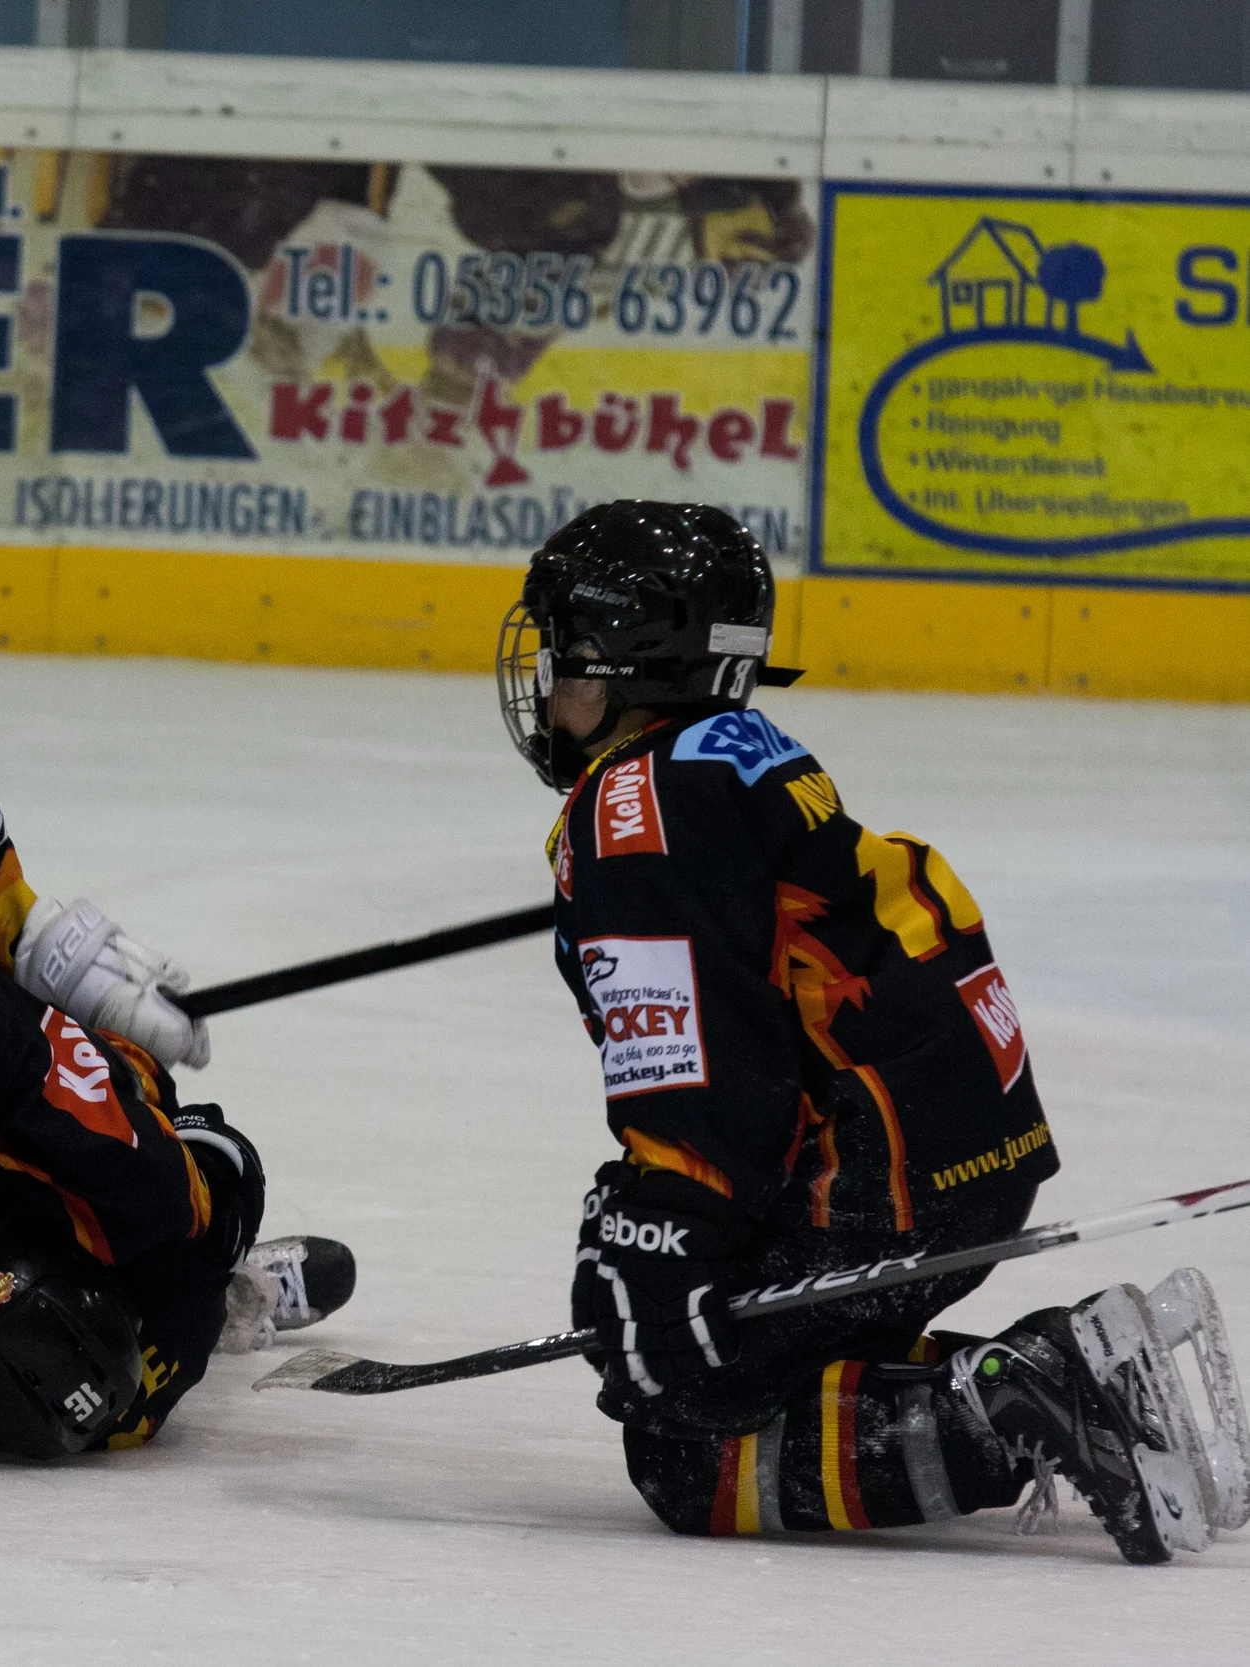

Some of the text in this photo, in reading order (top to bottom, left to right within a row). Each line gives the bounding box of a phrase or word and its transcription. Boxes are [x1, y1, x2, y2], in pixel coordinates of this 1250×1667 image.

[616, 260, 804, 344] 63962
[611, 759, 647, 842] Kelly's
[605, 1003, 691, 1043] CKEY
[600, 1211, 691, 1257] ebok
